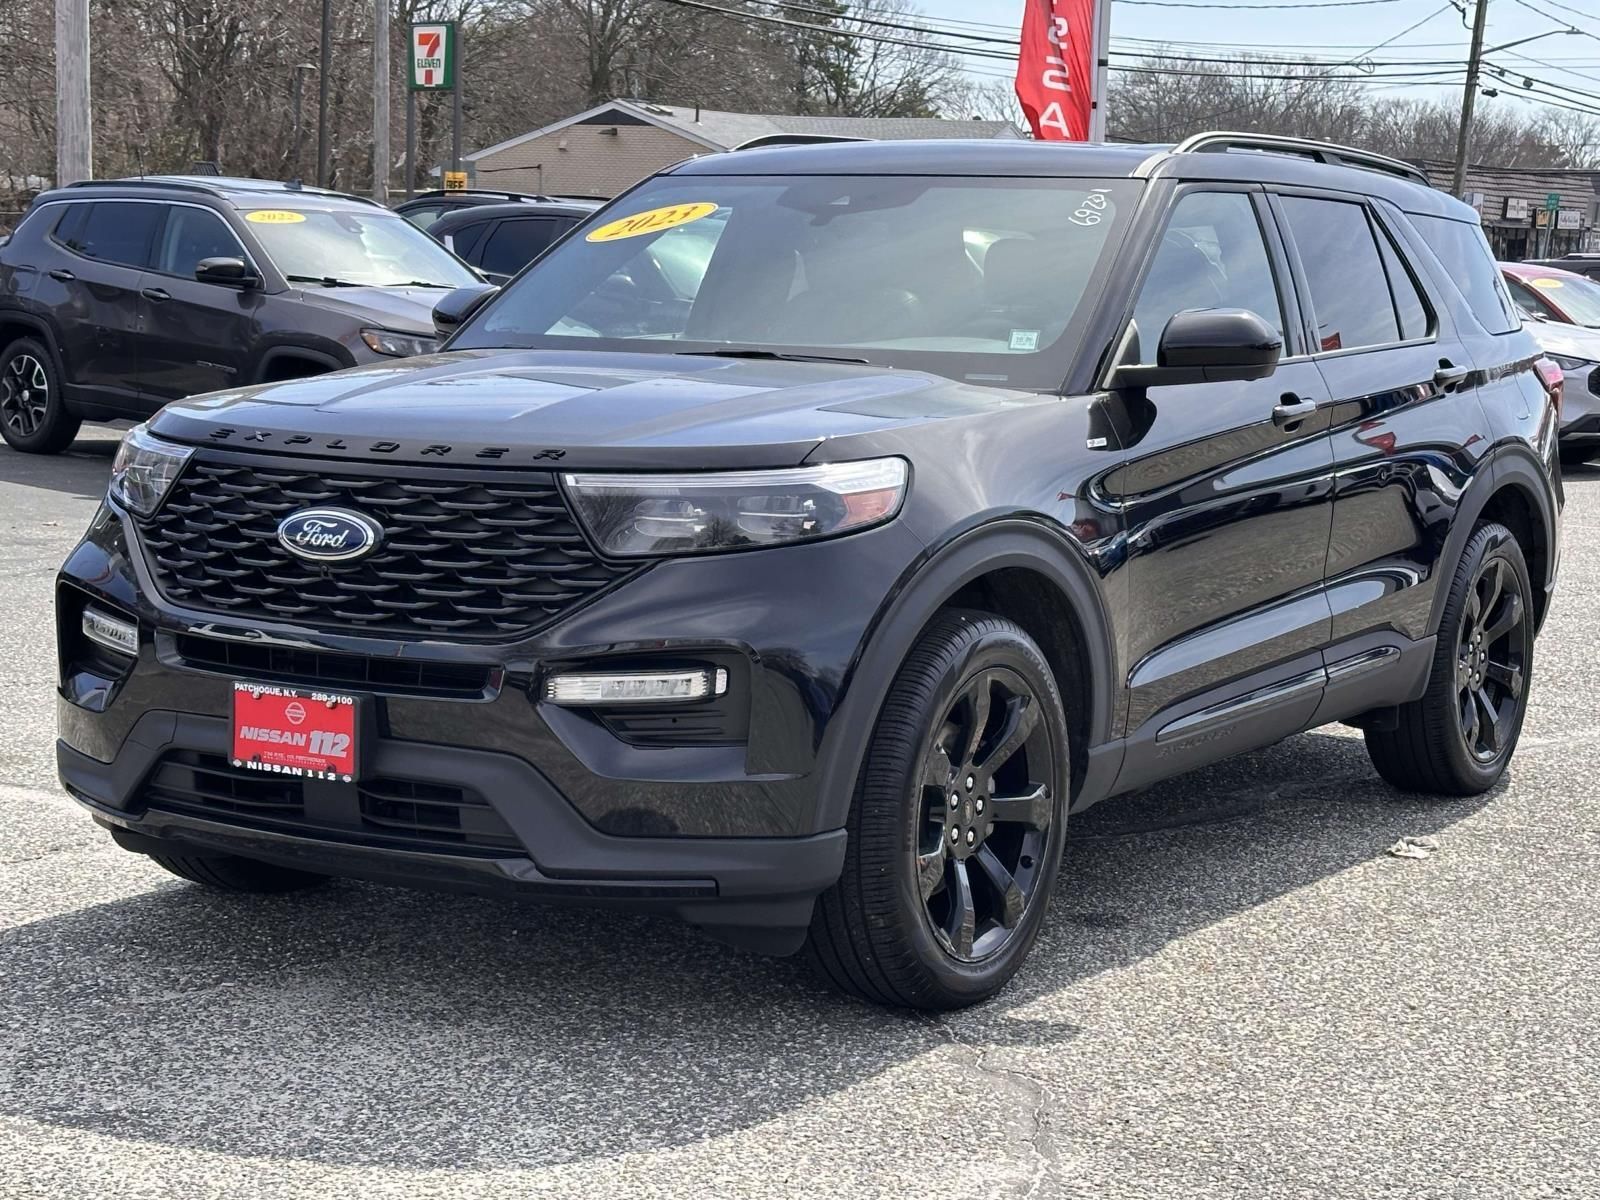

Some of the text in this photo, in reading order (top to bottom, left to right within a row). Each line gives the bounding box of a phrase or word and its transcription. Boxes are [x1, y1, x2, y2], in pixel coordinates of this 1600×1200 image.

[418, 33, 440, 84] 7
[604, 205, 699, 238] 2023
[209, 427, 567, 461] EXPLORER
[296, 519, 350, 549] Ford
[283, 689, 299, 698] N.Y.
[311, 692, 353, 706] 289-9100
[239, 726, 307, 747] NISSAN
[308, 730, 350, 758] 112
[246, 761, 303, 776] NISSAN
